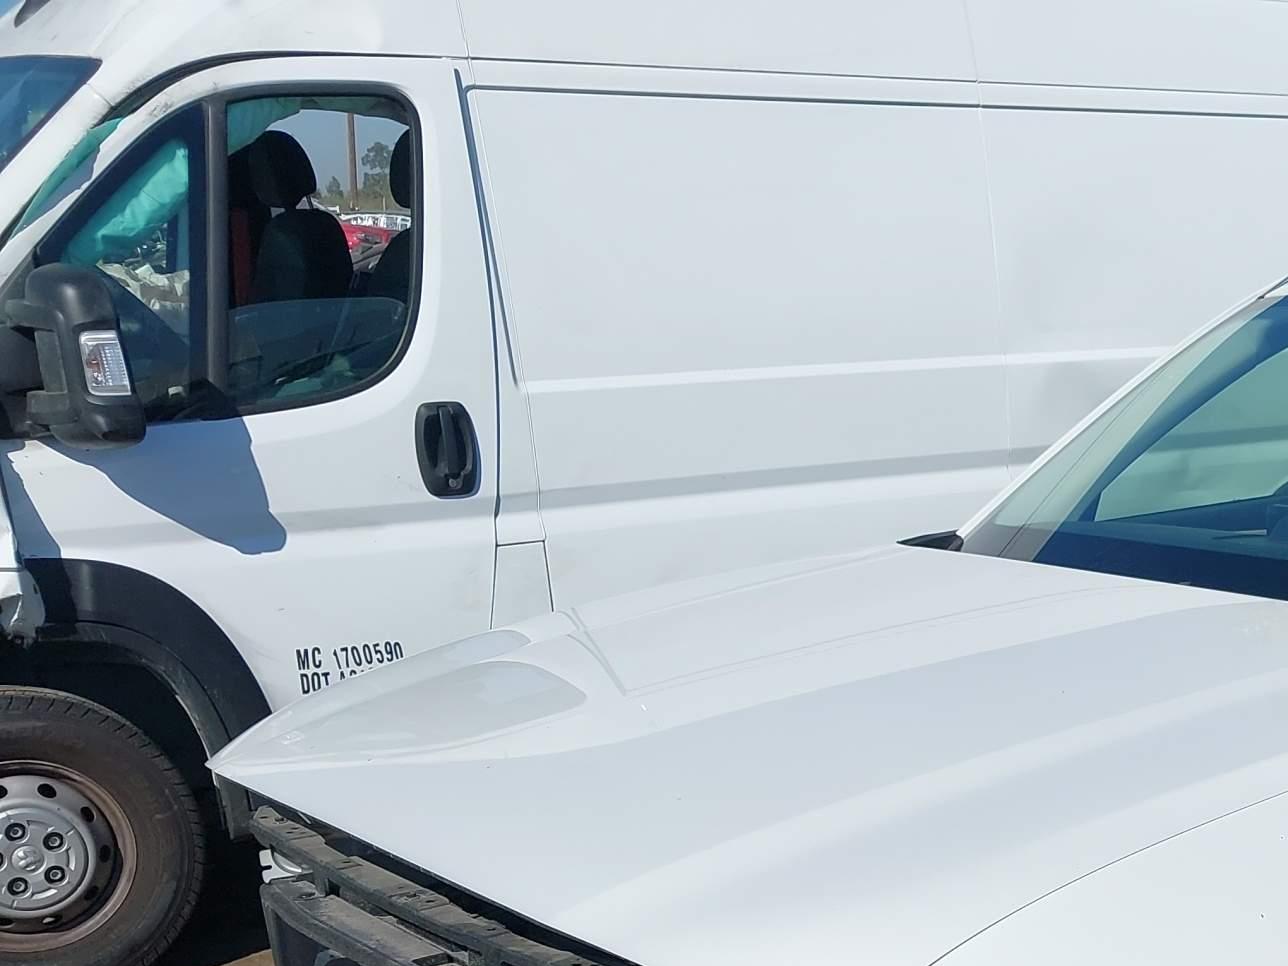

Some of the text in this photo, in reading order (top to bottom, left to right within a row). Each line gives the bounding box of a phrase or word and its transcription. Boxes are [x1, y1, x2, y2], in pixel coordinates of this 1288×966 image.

[296, 641, 404, 670] MC 1700590
[300, 671, 330, 695] DOT
